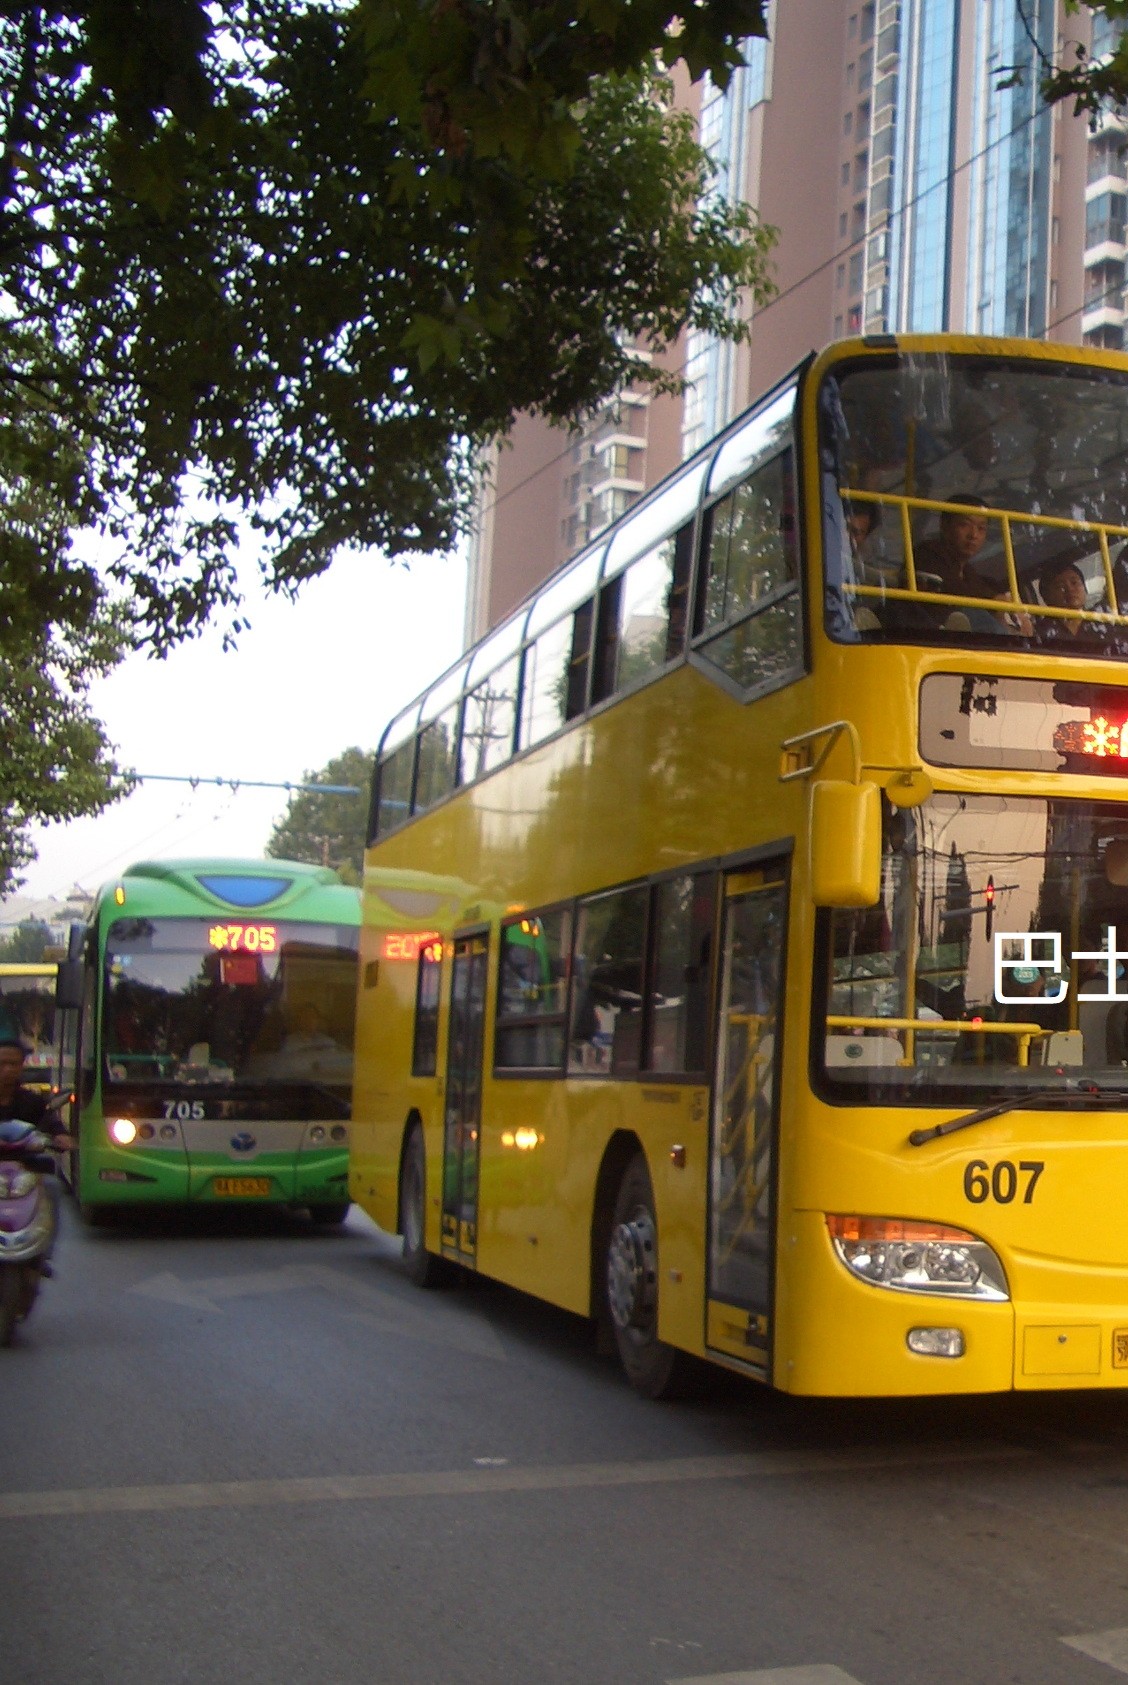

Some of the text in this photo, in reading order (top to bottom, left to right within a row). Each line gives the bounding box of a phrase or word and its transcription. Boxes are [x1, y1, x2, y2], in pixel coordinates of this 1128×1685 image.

[227, 925, 276, 952] 705
[162, 1100, 206, 1120] 705
[963, 1159, 1045, 1204] 607
